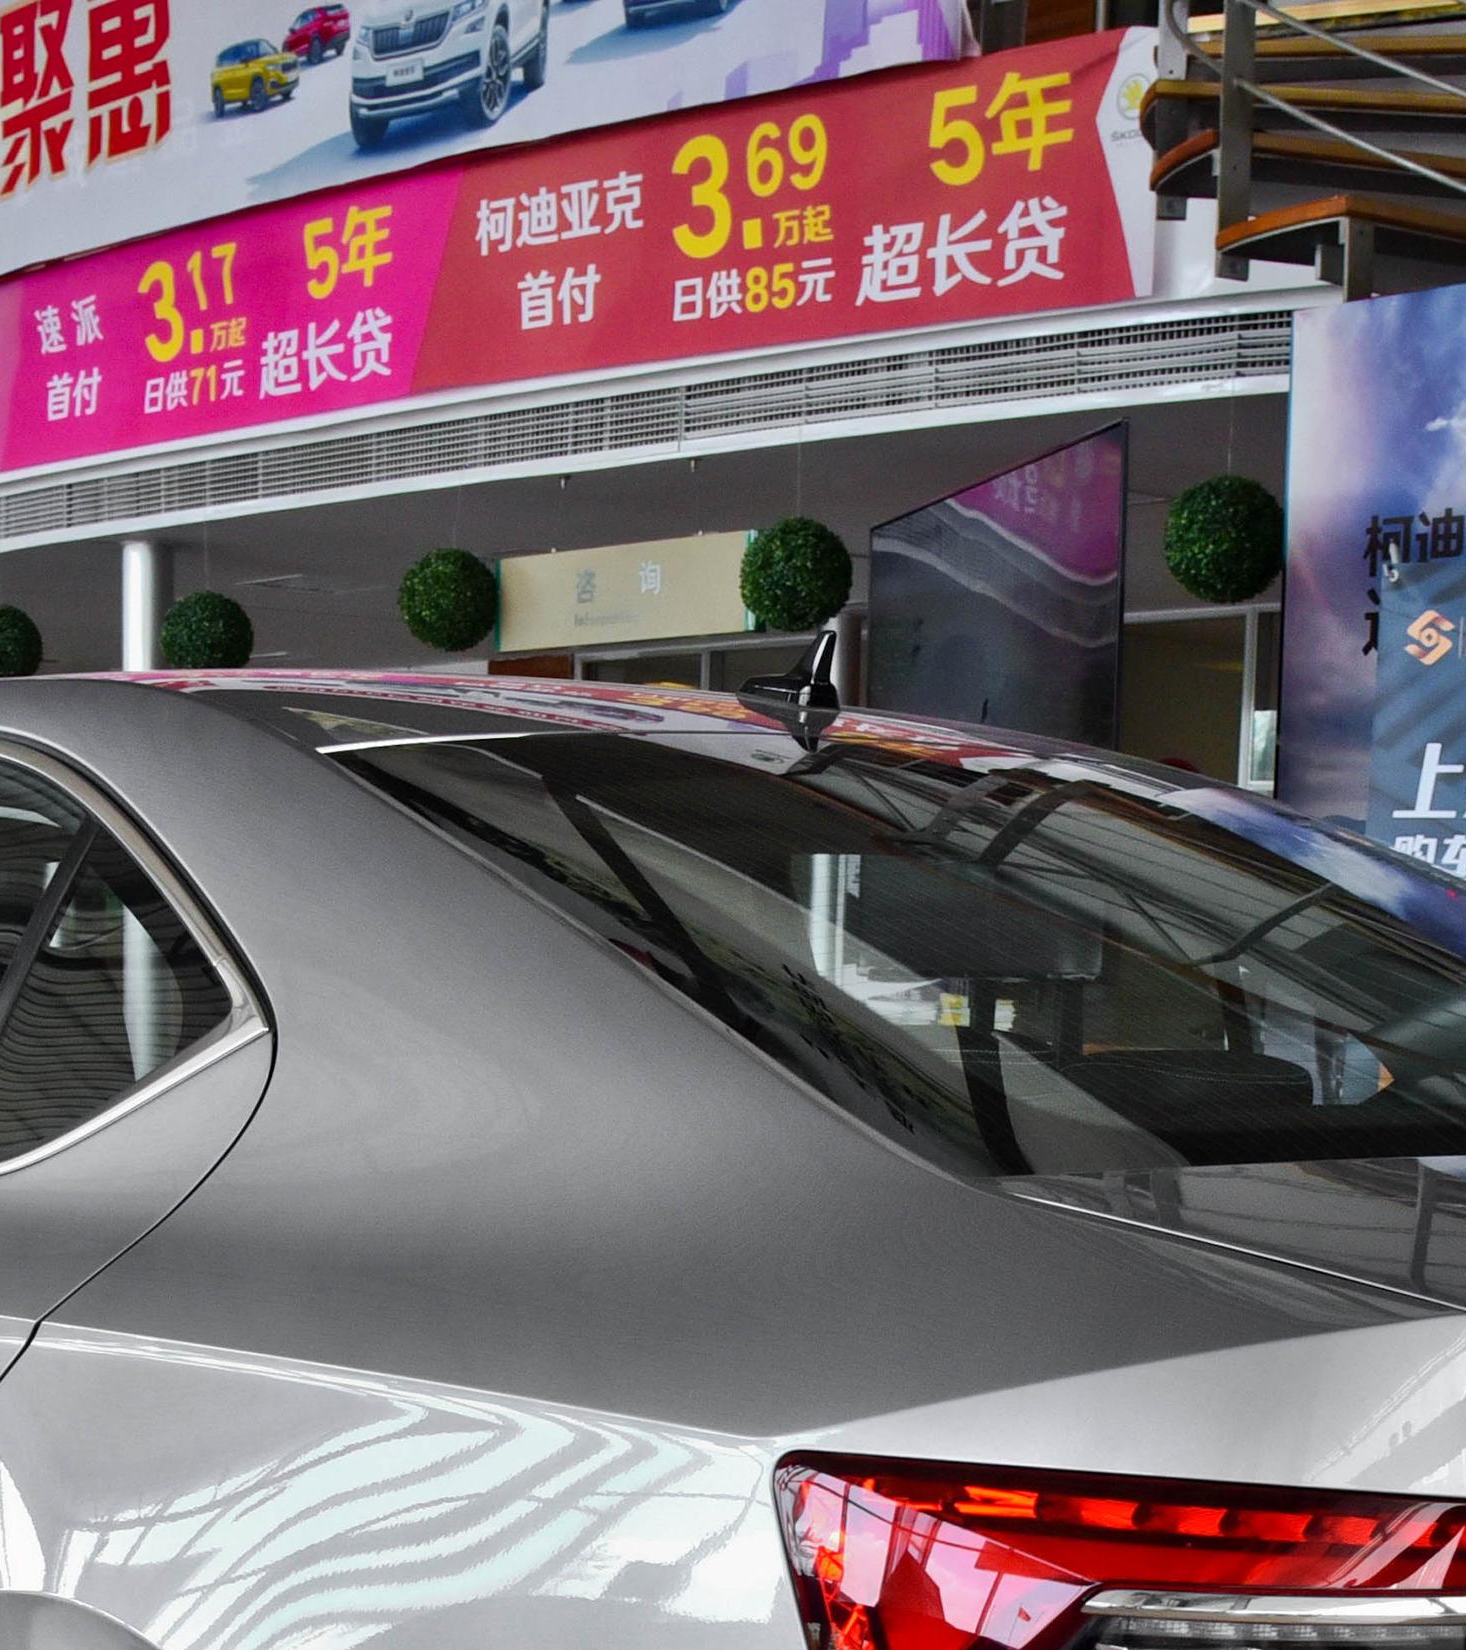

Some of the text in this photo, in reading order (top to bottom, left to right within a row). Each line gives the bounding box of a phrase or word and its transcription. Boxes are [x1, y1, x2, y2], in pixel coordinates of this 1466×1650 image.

[929, 71, 1074, 186] 5年
[475, 171, 644, 256] 柯迪亚克
[773, 205, 834, 248] 万起
[303, 205, 393, 299] 5年
[855, 196, 1067, 306] 超长贷
[517, 263, 601, 330] 首付
[671, 257, 836, 322] 日供85元
[34, 295, 104, 355] 速派
[209, 317, 247, 352] 万起
[259, 307, 393, 399] 超长贷
[46, 367, 102, 421] 首付
[143, 359, 246, 414] 日供71元
